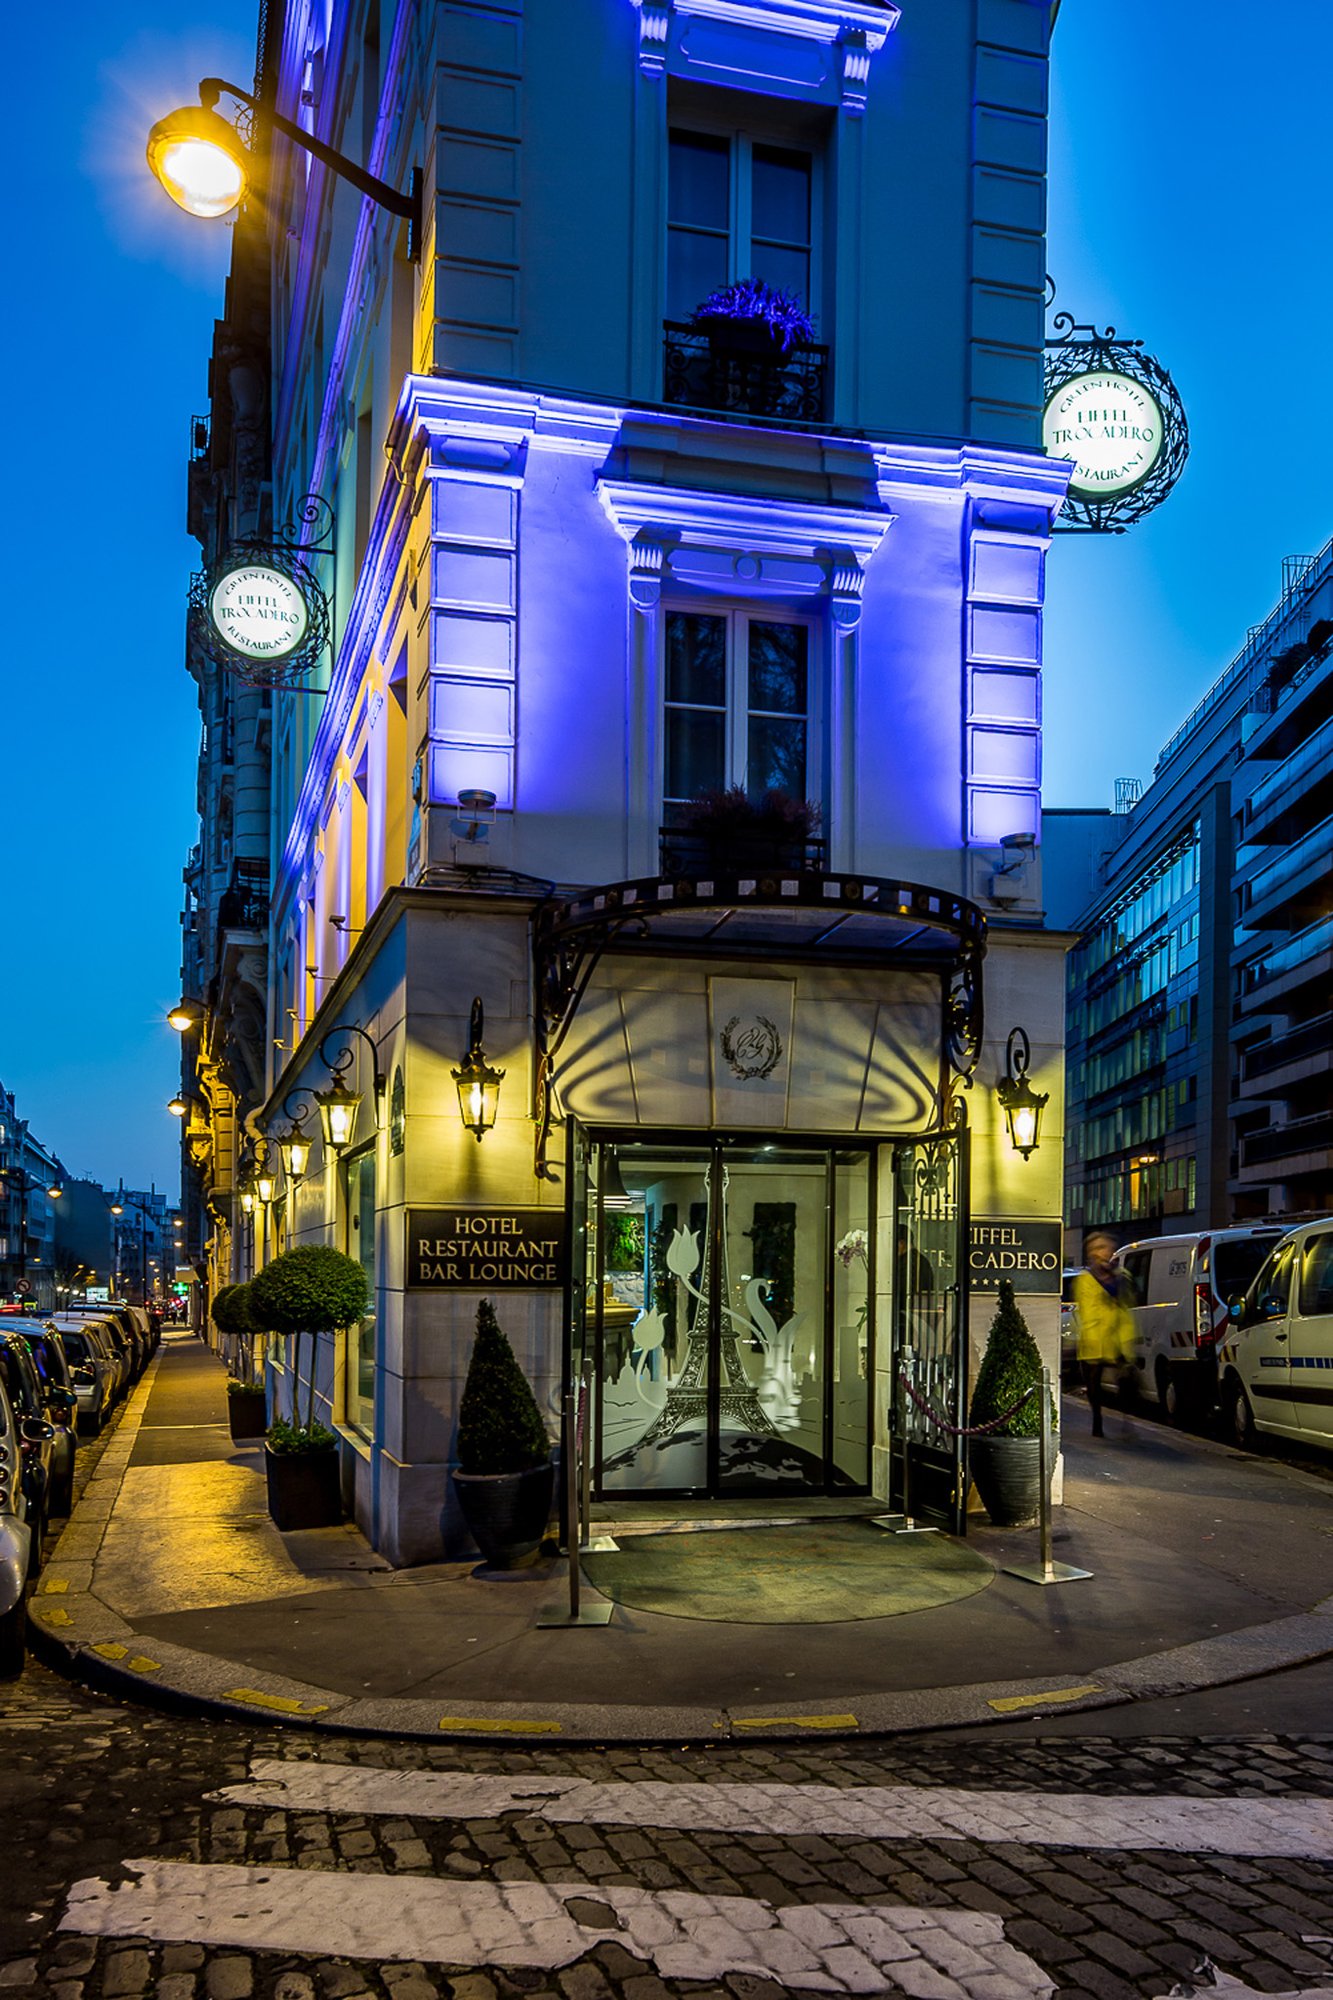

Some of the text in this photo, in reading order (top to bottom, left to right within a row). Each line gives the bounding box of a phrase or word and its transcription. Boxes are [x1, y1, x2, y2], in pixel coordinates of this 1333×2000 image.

[1106, 381, 1145, 411] HOTEL
[1077, 409, 1133, 423] EIFFEL
[1052, 426, 1154, 445] TROCADERO
[1062, 450, 1145, 481] RSTAURANT
[238, 594, 280, 608] EIFFEL
[220, 607, 300, 625] TROCADERO
[227, 625, 292, 651] RESTAURANT
[454, 1217, 523, 1235] HOTEL
[418, 1239, 559, 1258] RESTAURANT
[419, 1263, 558, 1281] BAR LOUNGE
